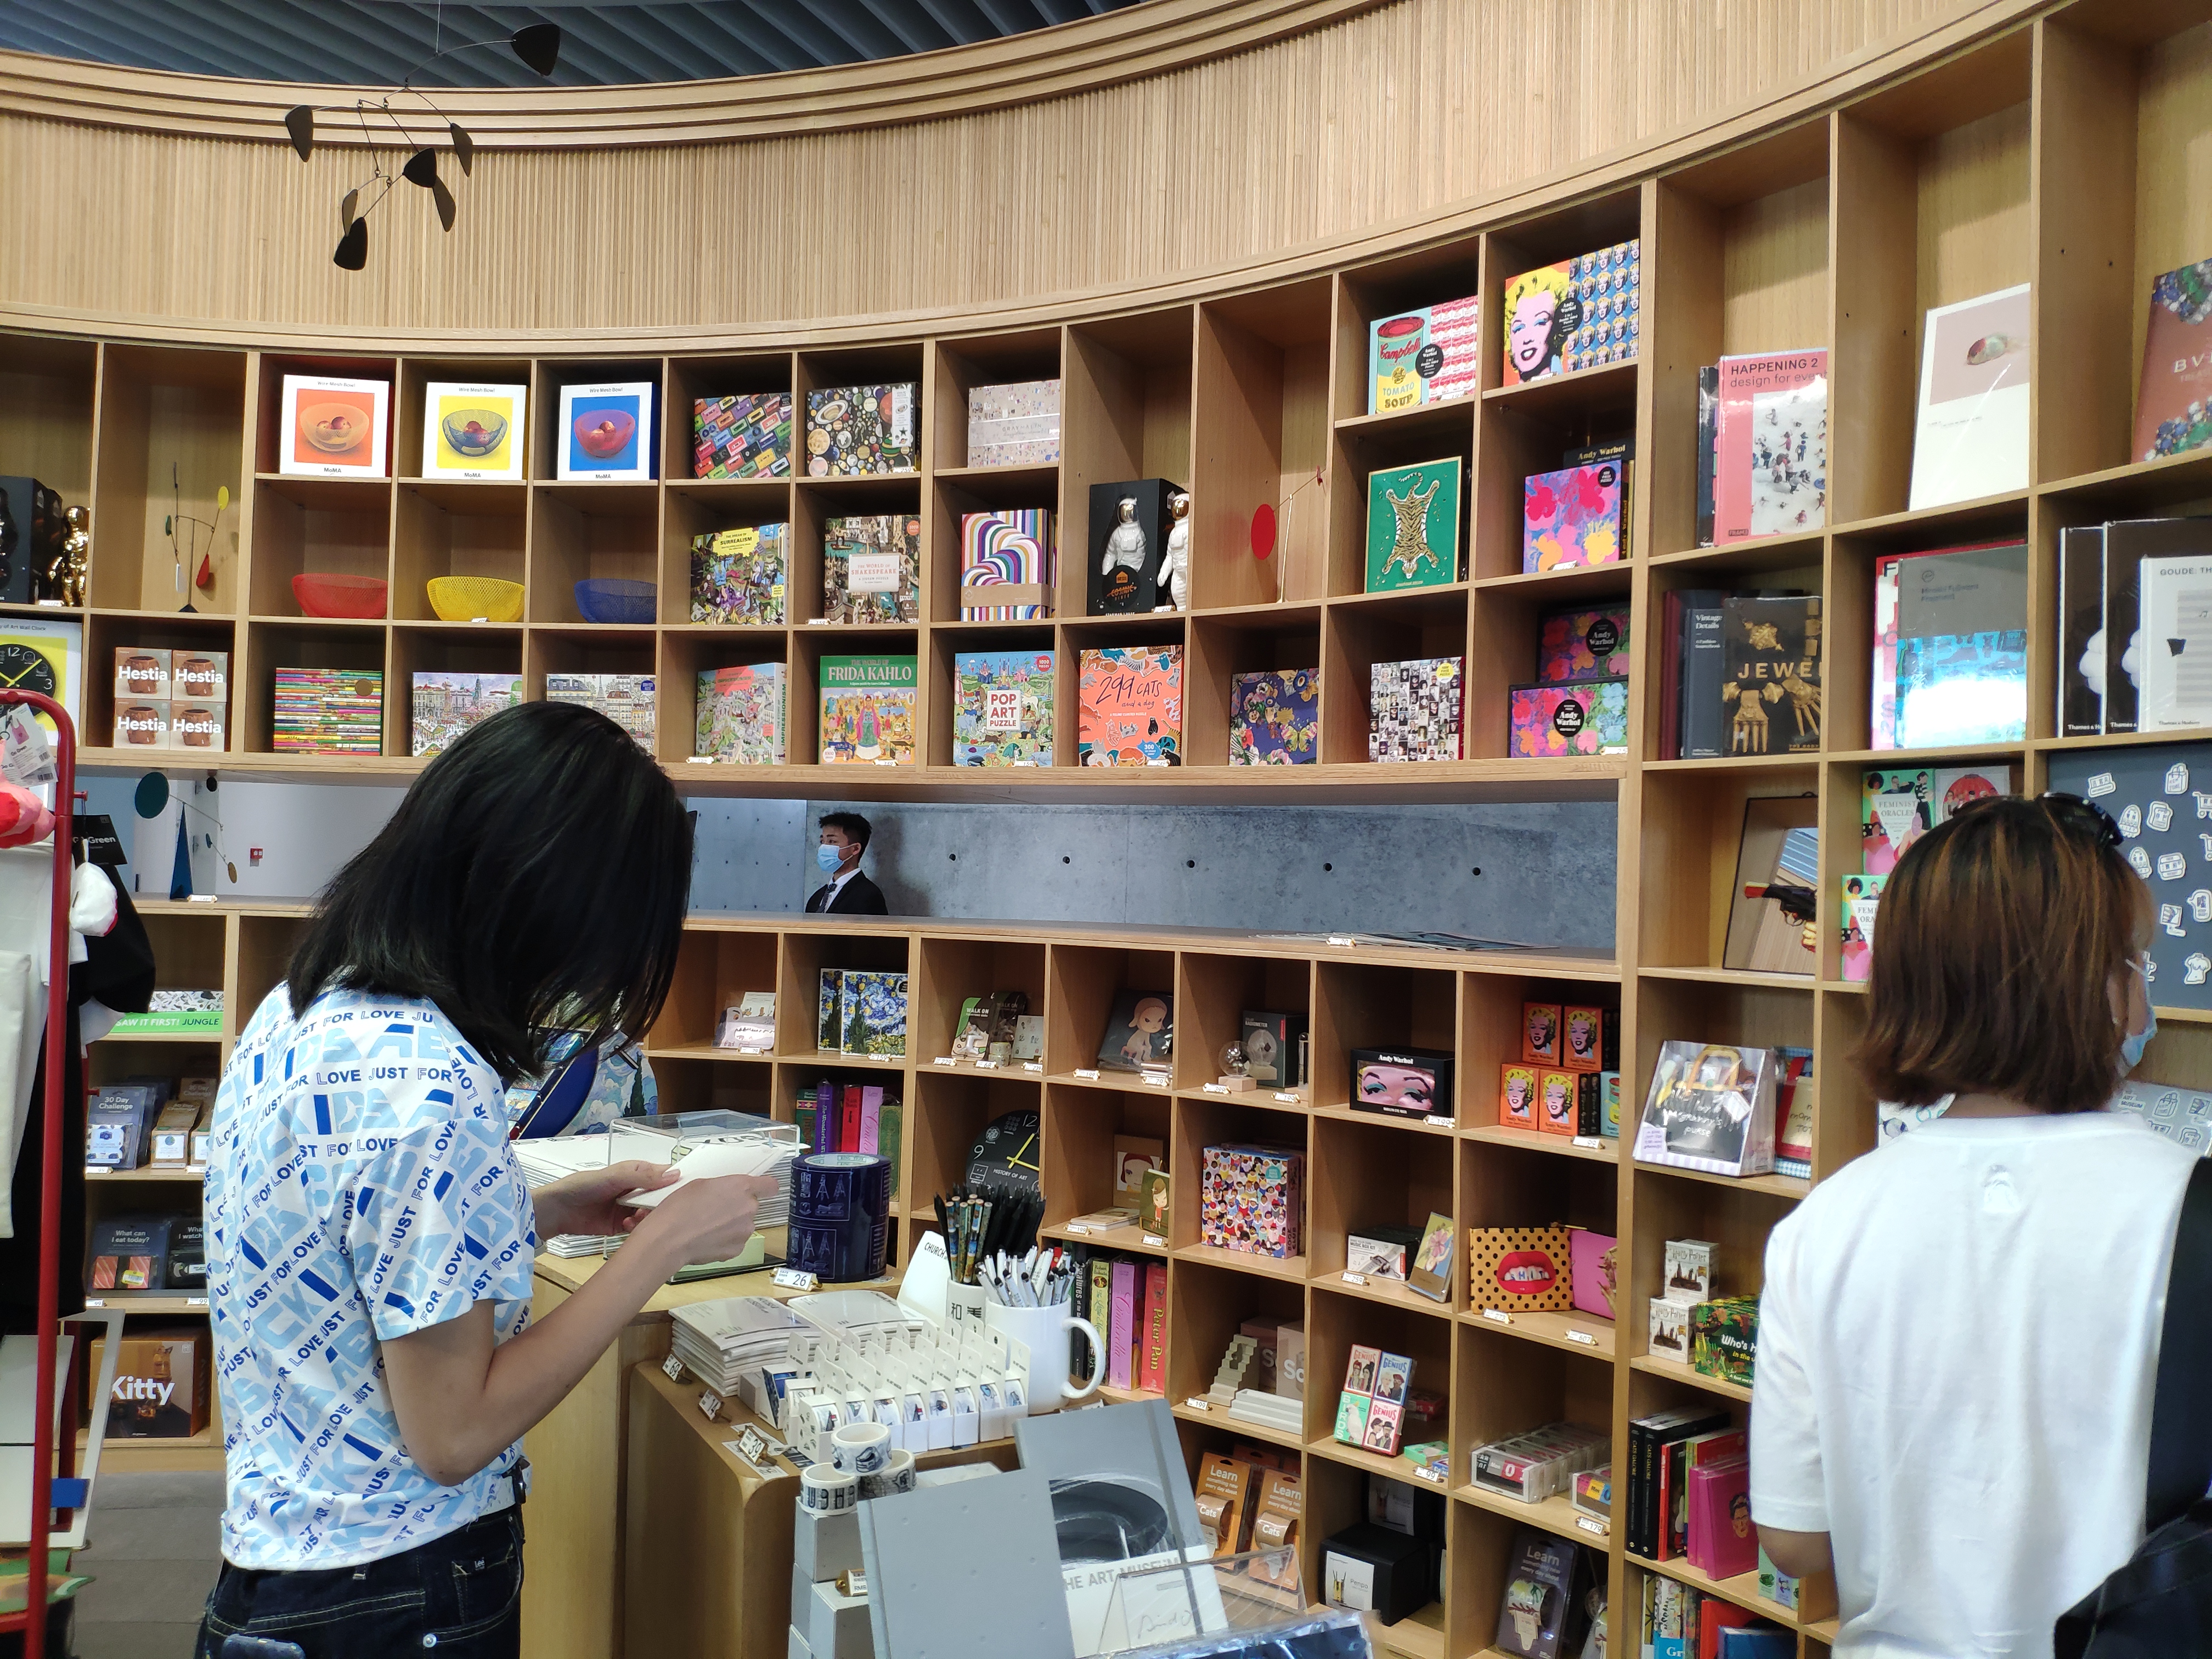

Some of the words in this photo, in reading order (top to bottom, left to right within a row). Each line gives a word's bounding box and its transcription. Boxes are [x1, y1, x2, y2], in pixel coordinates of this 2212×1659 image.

[1731, 362, 1807, 375] HAPPENING
[1811, 358, 1818, 368] 2
[1730, 375, 1770, 387] design
[1774, 373, 1790, 383] for
[1383, 382, 1414, 396] TOMATO
[1385, 393, 1413, 408] SOUP
[1578, 451, 1597, 461] Andy
[1599, 444, 1626, 455] Warhol
[720, 537, 752, 545] SURREALISM
[1695, 614, 1723, 622] Vintage
[1593, 631, 1611, 639] Andy
[8, 647, 21, 657] 12
[119, 666, 168, 681] Hestia
[175, 668, 224, 683] Hestia
[828, 667, 866, 680] FRIDA
[868, 666, 912, 680] KAHLO
[1737, 662, 1822, 679] JEWE
[43, 678, 53, 690] 3
[1096, 674, 1135, 704] 299
[1136, 680, 1163, 697] CATS
[991, 693, 1017, 705] POP
[1143, 699, 1155, 710] dog
[991, 707, 1017, 718] ART
[117, 716, 167, 731] Hestia
[173, 719, 222, 733] Hestia
[150, 1018, 180, 1026] FIRST!
[182, 1018, 219, 1026] JUNGLE
[323, 1011, 354, 1028] FOR
[360, 1010, 405, 1020] LOVE
[1378, 1054, 1393, 1063] Andy
[1393, 1056, 1414, 1064] Warhol
[316, 1069, 362, 1086] LOVE
[368, 1067, 408, 1081] JUST
[417, 1067, 453, 1084] FOR
[1022, 1115, 1037, 1127] 12
[1683, 1127, 1711, 1137] purse
[973, 1144, 984, 1160] 9
[270, 1152, 304, 1188] LOVE
[993, 1169, 1011, 1177] HISTORY
[386, 1205, 418, 1249] JUST
[411, 1165, 435, 1200] FOR
[428, 1119, 458, 1163] LOVE
[471, 1165, 505, 1197] FOR
[490, 1239, 522, 1271] FOR
[924, 1242, 947, 1260] CHURCH
[1673, 1249, 1688, 1260] Harry
[1689, 1249, 1707, 1262] Potter
[792, 1274, 807, 1287] 26
[1511, 1269, 1544, 1280] SHIT
[1656, 1306, 1671, 1318] Harry
[1671, 1308, 1686, 1321] Potter
[1113, 1292, 1131, 1358] Cinderella
[1151, 1307, 1165, 1344] Peter
[1721, 1334, 1748, 1351] Who's
[1150, 1345, 1163, 1370] Pan
[1354, 1349, 1376, 1362] GENIUS
[1740, 1352, 1750, 1361] the
[669, 1361, 680, 1377] 69
[1383, 1357, 1407, 1373] GENIUS
[110, 1374, 175, 1406] Kitty
[1335, 1395, 1351, 1438] BIRDS
[1373, 1404, 1397, 1421] GENIUS
[748, 1438, 761, 1458] 39
[1210, 1464, 1238, 1482] Learn
[1490, 1462, 1501, 1470] Mon
[1207, 1476, 1229, 1487] something
[1426, 1471, 1436, 1480] 99
[1225, 1487, 1238, 1496] about
[1273, 1482, 1301, 1500] Learn
[1269, 1494, 1293, 1506] something
[1200, 1506, 1217, 1519] Cats
[1262, 1525, 1280, 1537] Cats
[1590, 1523, 1602, 1532] 179
[1526, 1545, 1560, 1567] Learn
[1089, 1570, 1115, 1586] ART
